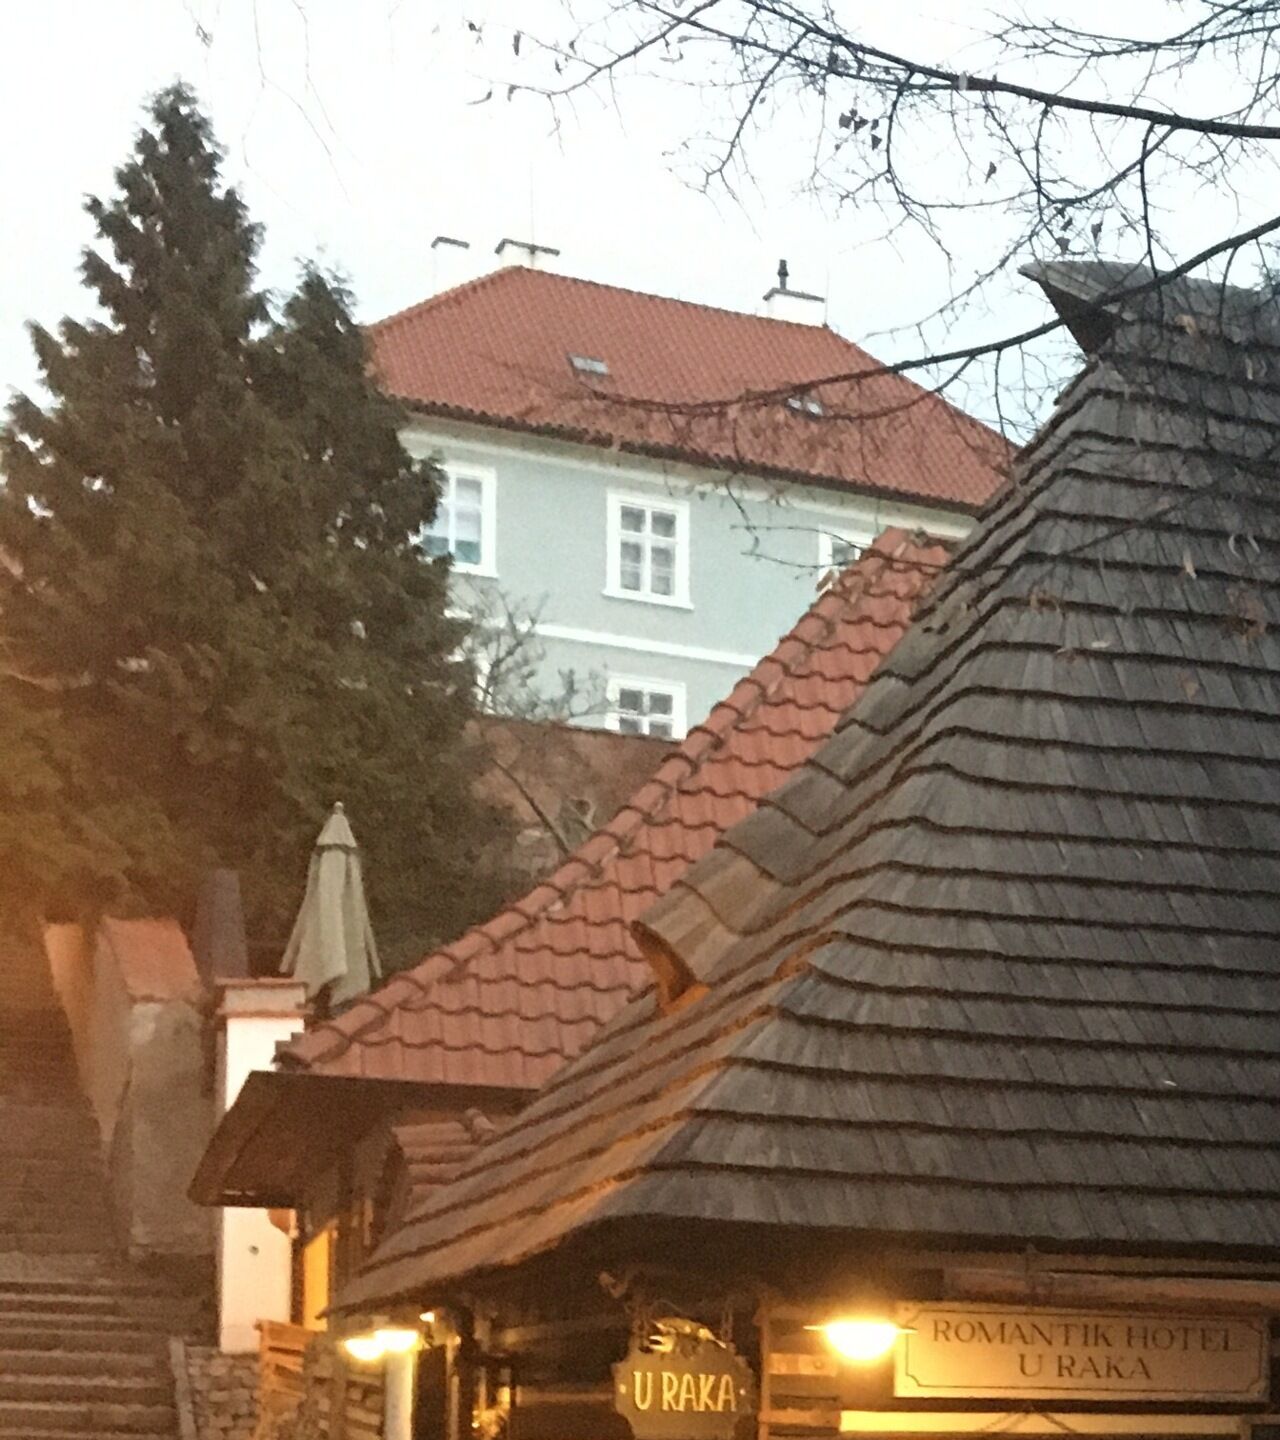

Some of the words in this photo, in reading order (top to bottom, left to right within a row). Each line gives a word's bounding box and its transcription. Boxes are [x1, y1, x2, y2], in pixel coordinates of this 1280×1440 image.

[932, 1319, 1113, 1348] ROMANTIK
[1126, 1325, 1243, 1353] HOTEL
[1018, 1353, 1044, 1378] U
[1056, 1354, 1153, 1380] RAKA
[633, 1370, 653, 1411] U
[661, 1371, 737, 1412] RAKA
